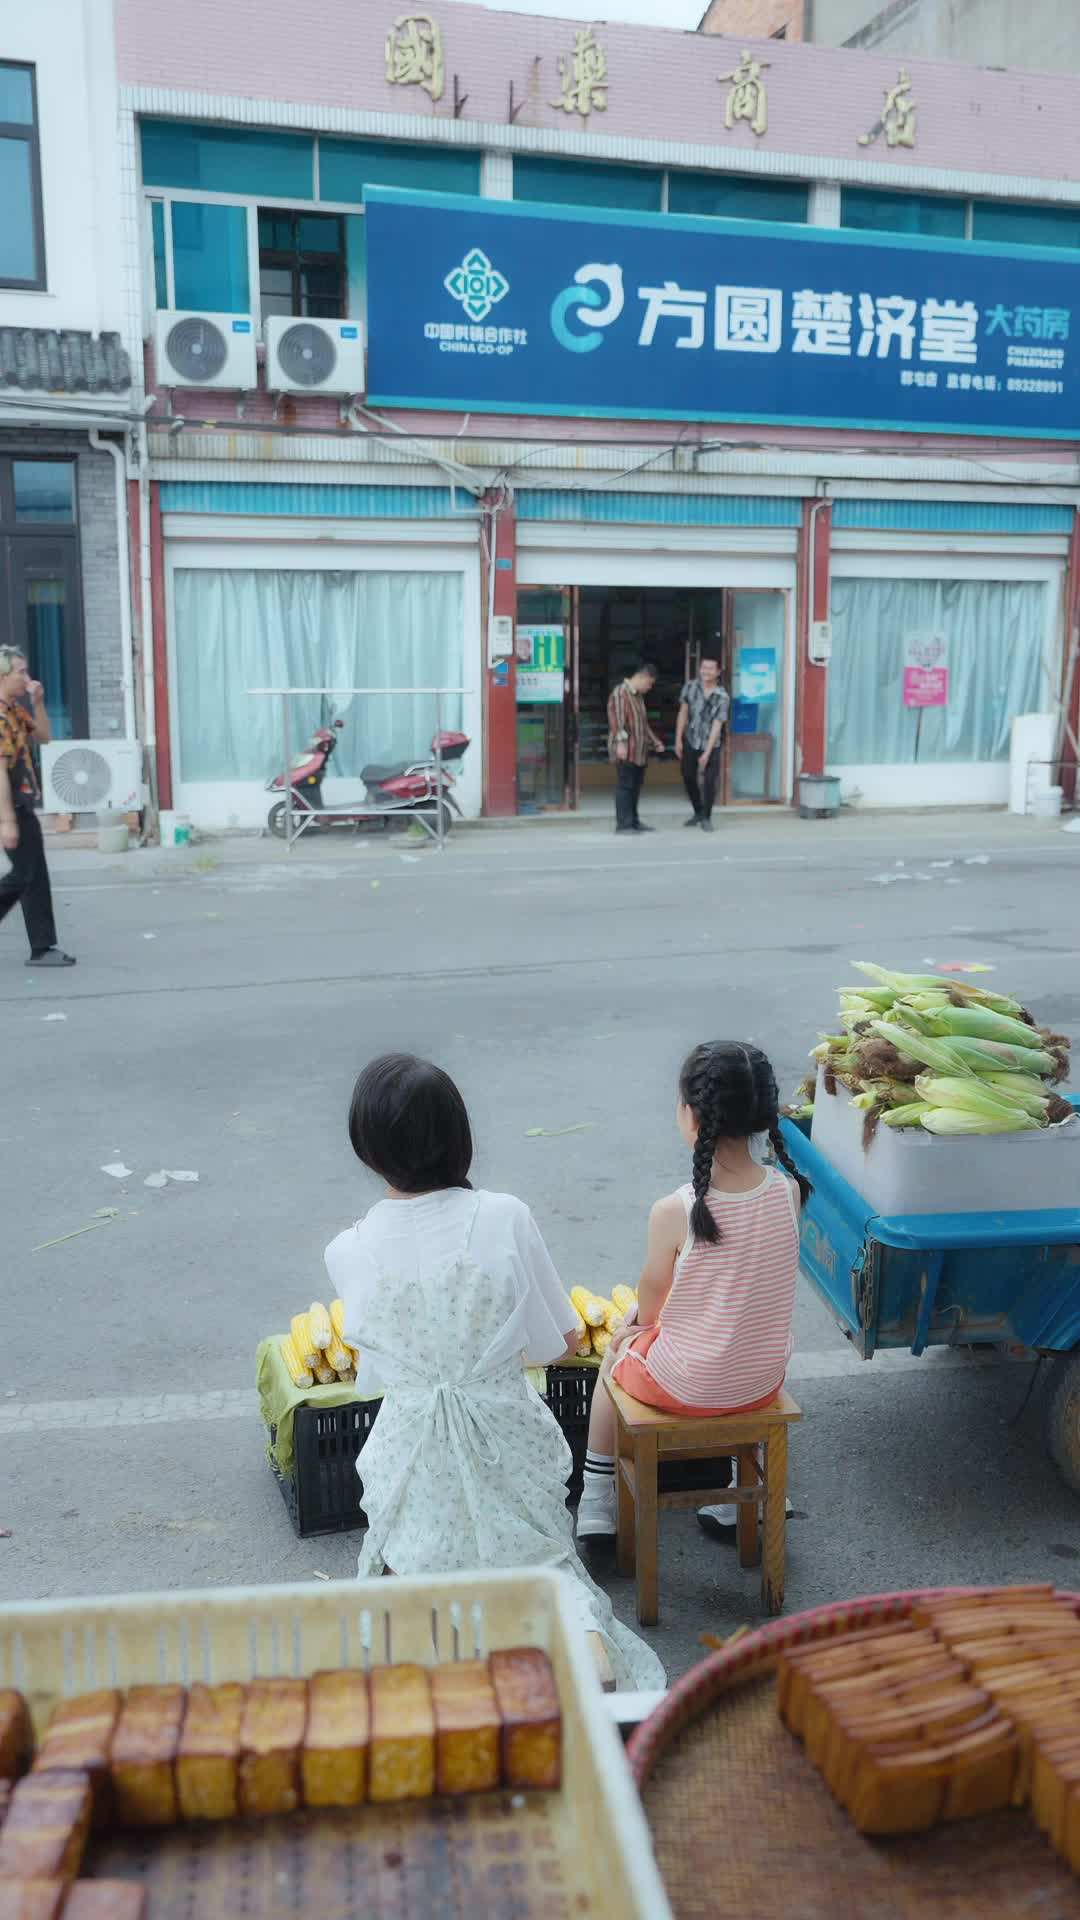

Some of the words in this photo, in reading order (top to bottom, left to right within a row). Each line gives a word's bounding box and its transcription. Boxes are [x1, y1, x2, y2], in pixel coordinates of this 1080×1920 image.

[424, 322, 528, 345] 中国供销合作社
[637, 281, 979, 364] 方圆楚济堂
[985, 304, 1071, 340] 大药房
[439, 341, 476, 353] CHINA
